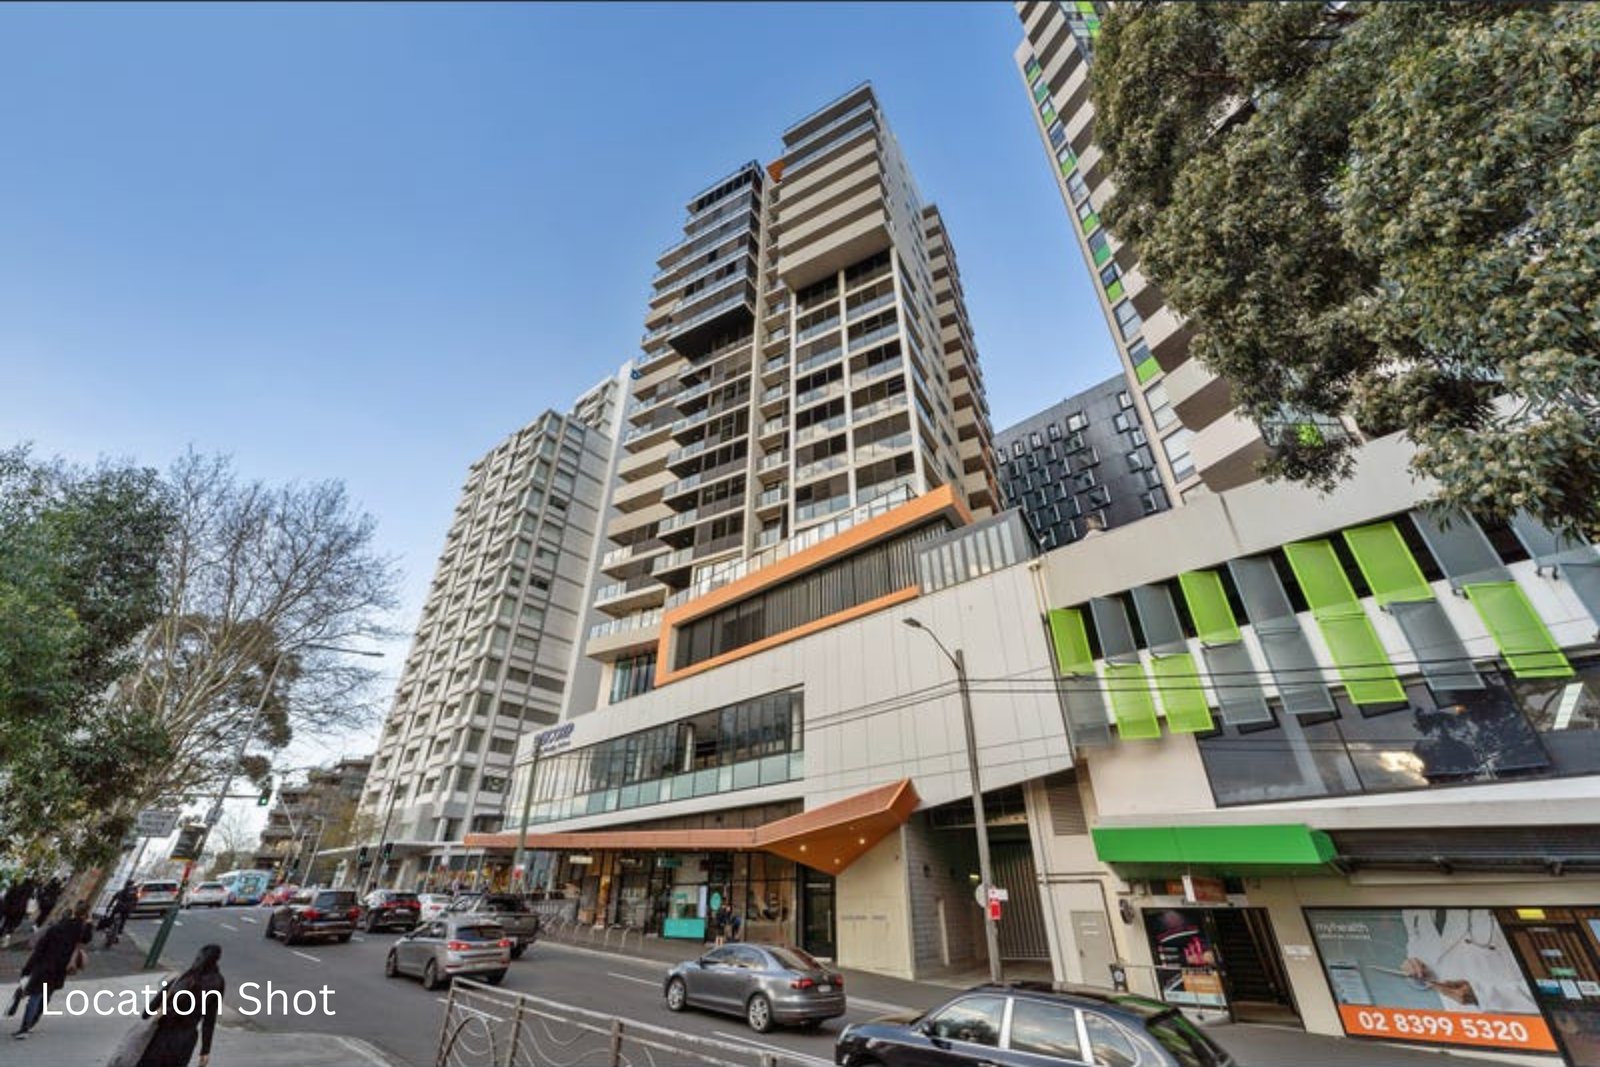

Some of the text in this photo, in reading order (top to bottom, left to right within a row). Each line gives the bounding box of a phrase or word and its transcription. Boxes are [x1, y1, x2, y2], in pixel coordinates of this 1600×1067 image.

[1358, 1010, 1529, 1042] 02 8399 5320
